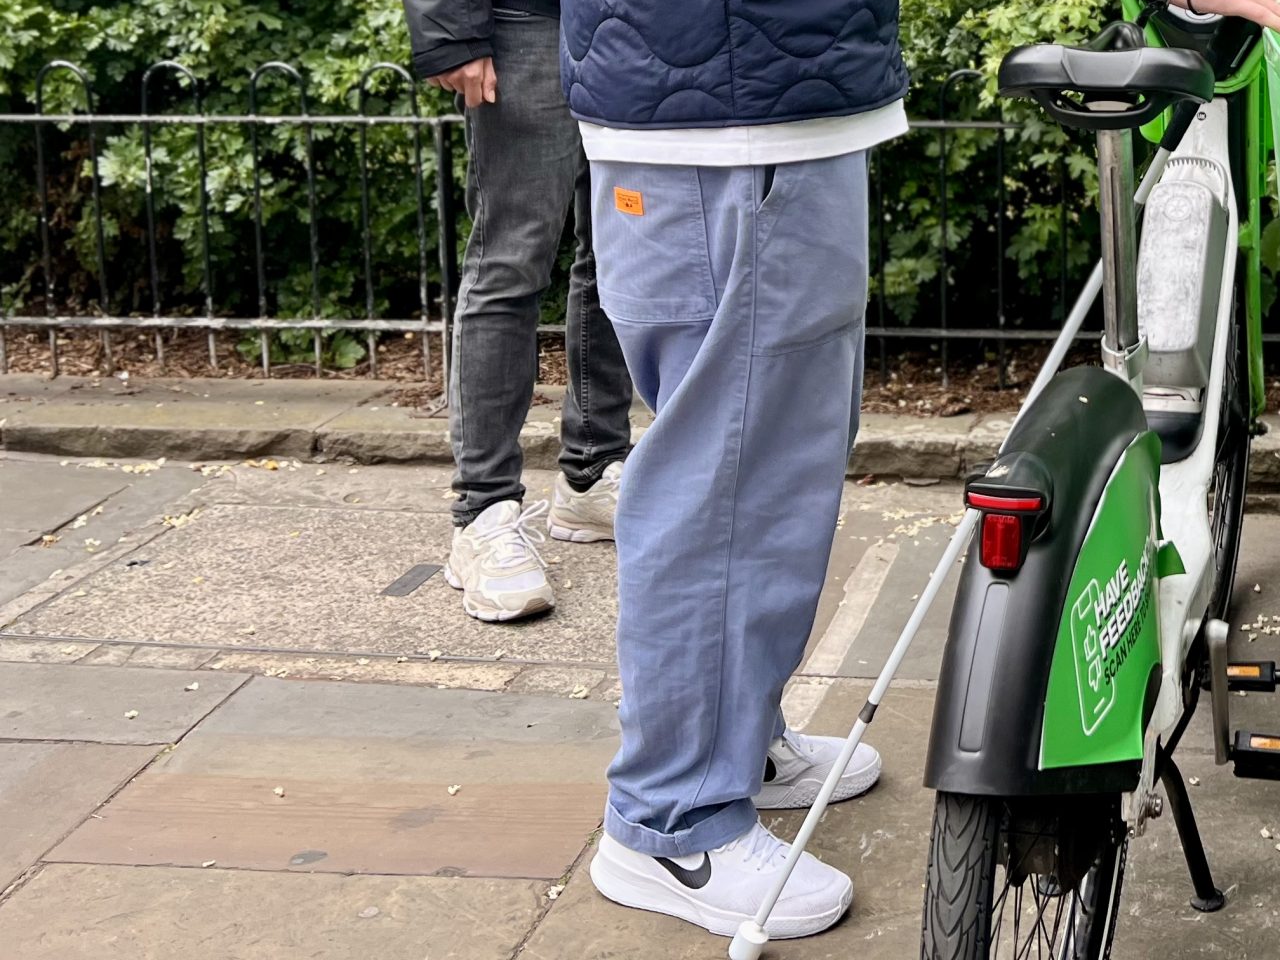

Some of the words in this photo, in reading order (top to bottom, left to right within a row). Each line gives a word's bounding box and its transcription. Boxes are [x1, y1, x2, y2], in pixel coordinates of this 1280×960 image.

[1094, 558, 1130, 627] HAVE
[1104, 644, 1128, 685] SCAN
[1125, 614, 1142, 655] HERE
